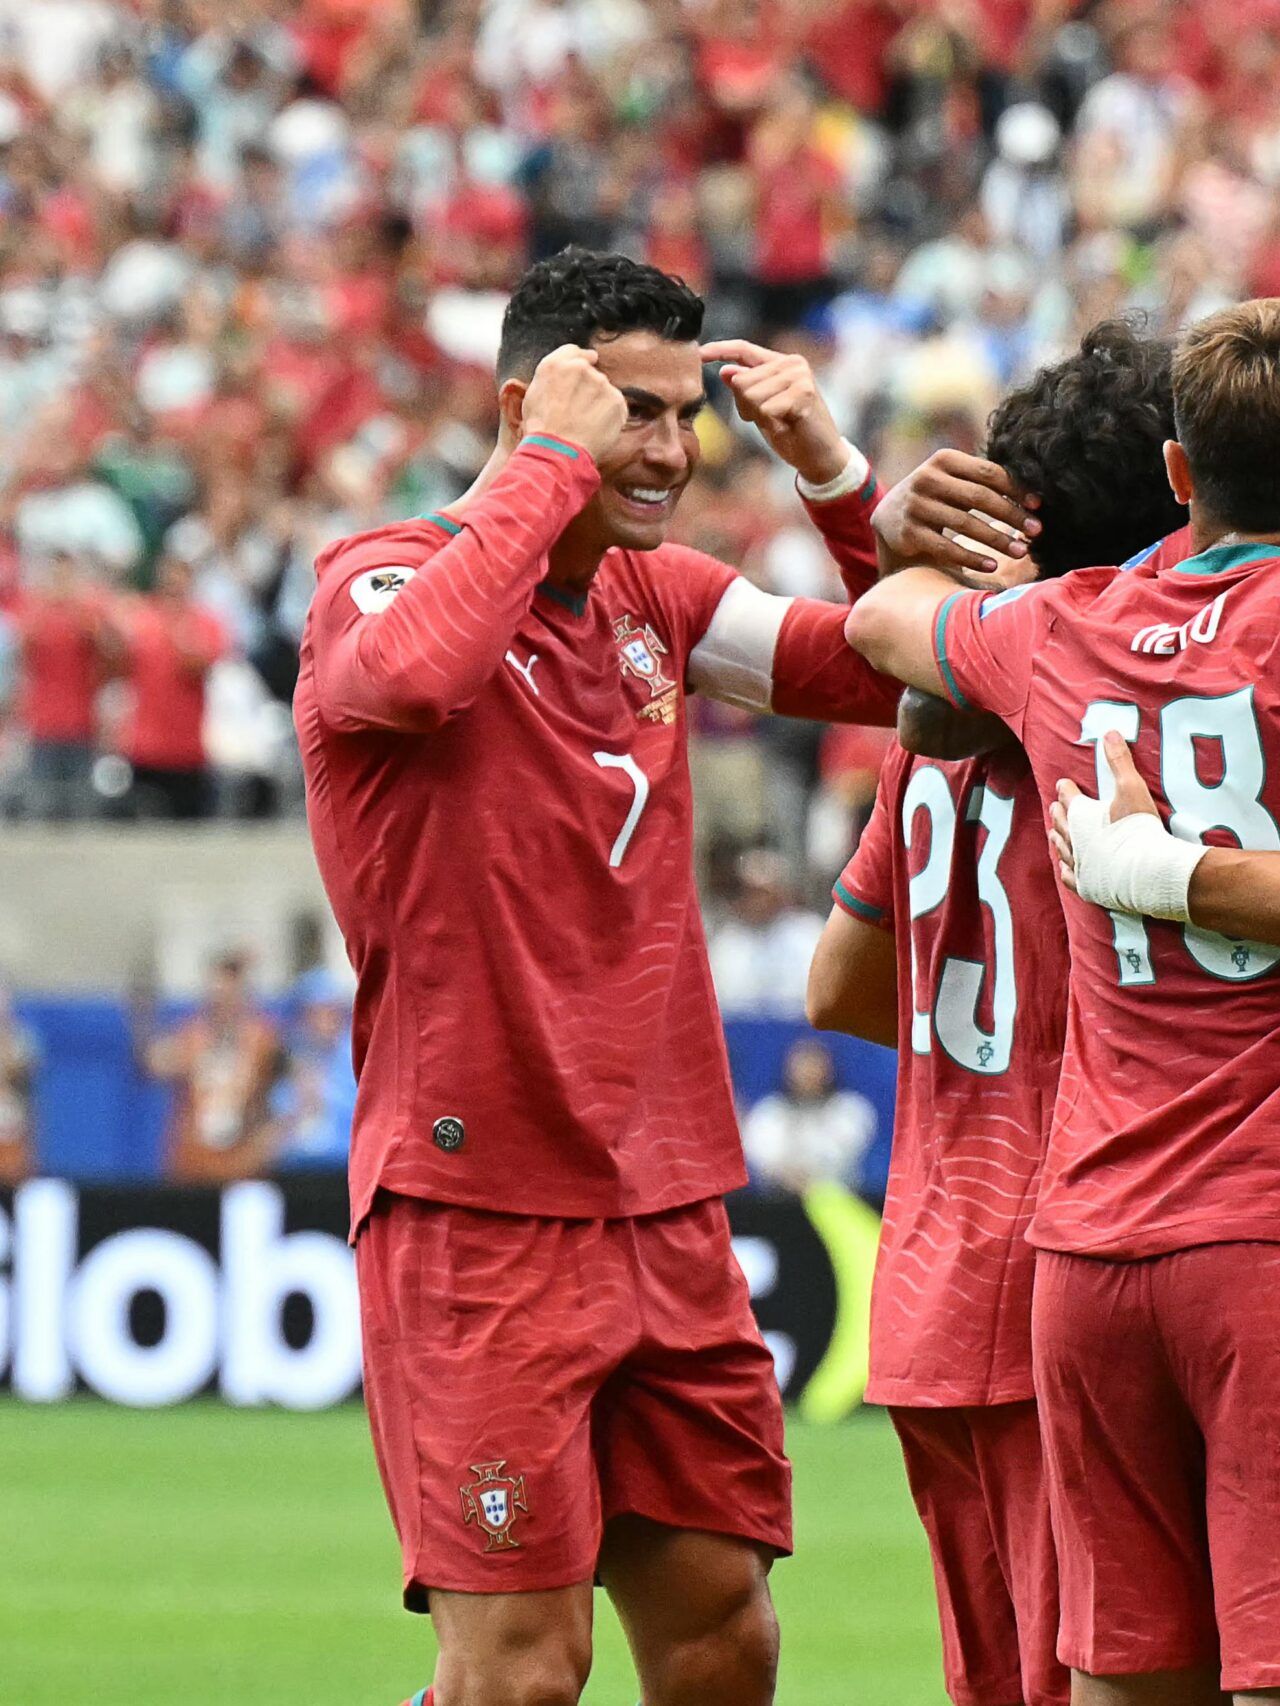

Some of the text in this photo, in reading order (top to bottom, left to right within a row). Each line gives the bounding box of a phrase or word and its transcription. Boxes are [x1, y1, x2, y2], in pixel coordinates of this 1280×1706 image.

[1130, 592, 1229, 655] NETO
[592, 750, 650, 868] 7
[901, 764, 1018, 1076] 23
[0, 1179, 364, 1409] lob
